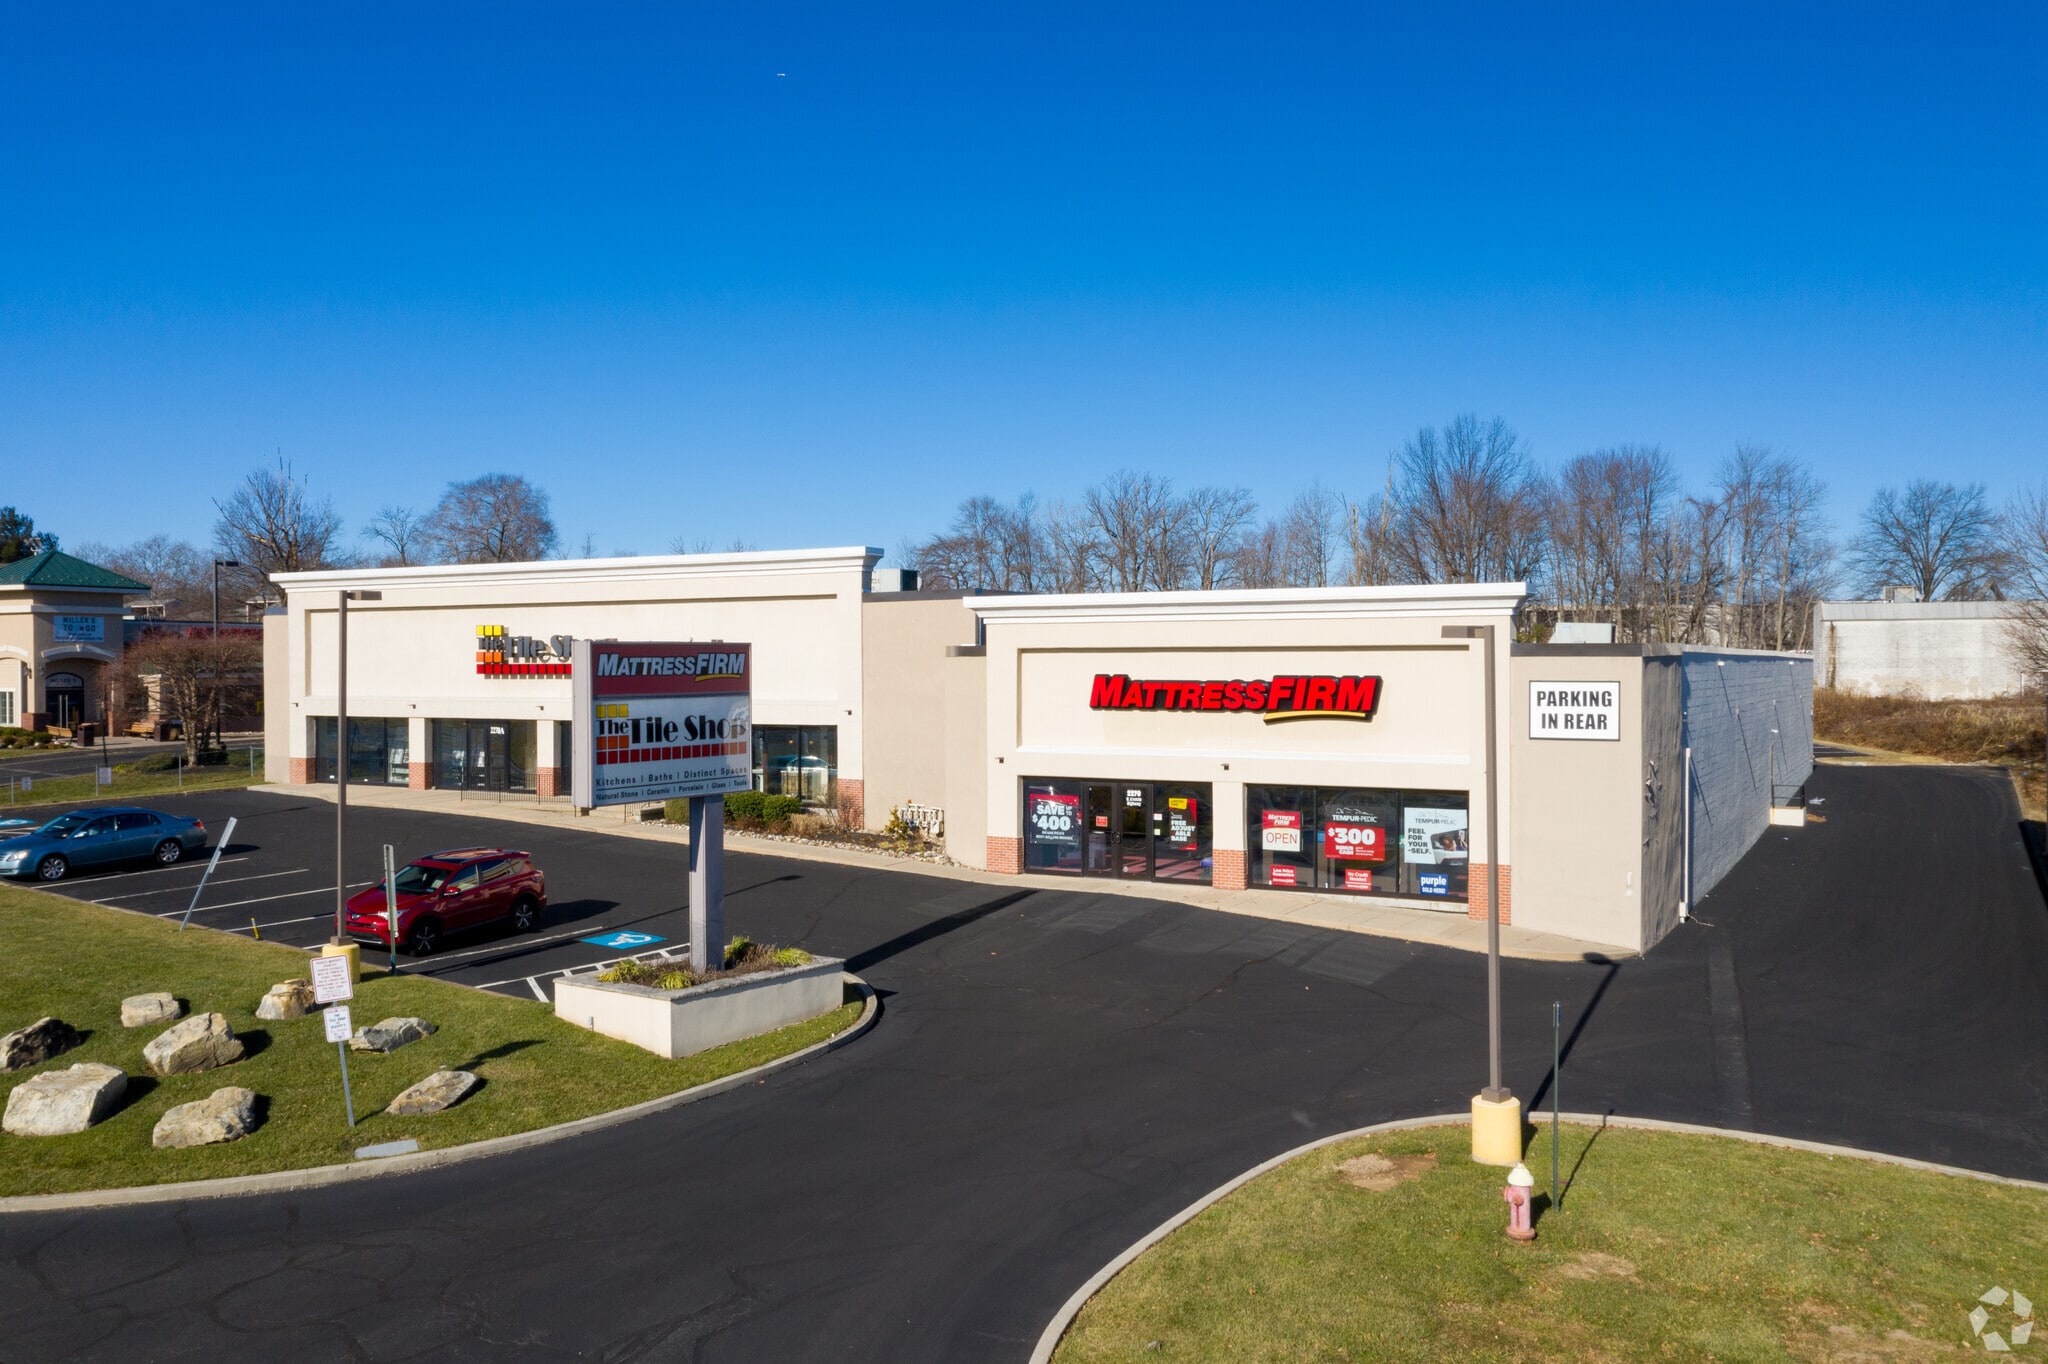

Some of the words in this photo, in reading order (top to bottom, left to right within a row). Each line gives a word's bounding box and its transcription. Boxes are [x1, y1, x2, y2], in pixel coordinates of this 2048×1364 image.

[86, 624, 96, 632] GO
[476, 637, 502, 650] The
[501, 635, 545, 658] Tile
[1537, 691, 1612, 707] PARKING
[1542, 713, 1558, 729] IN
[1564, 713, 1607, 729] REAR
[597, 720, 629, 735] The
[627, 717, 678, 744] Tile
[684, 715, 746, 742] Shop
[596, 776, 636, 787] Kitchens
[649, 774, 673, 782] Baths
[684, 769, 716, 778] Distinct
[720, 767, 747, 776] Spaces
[596, 791, 619, 800] Natural
[620, 791, 639, 799] Stone
[647, 788, 670, 796] Ceramic
[1037, 804, 1065, 816] SAVE
[1032, 814, 1071, 831] $400
[1266, 832, 1298, 844] OPEN
[1328, 827, 1375, 845] $300
[1421, 875, 1447, 887] purple
